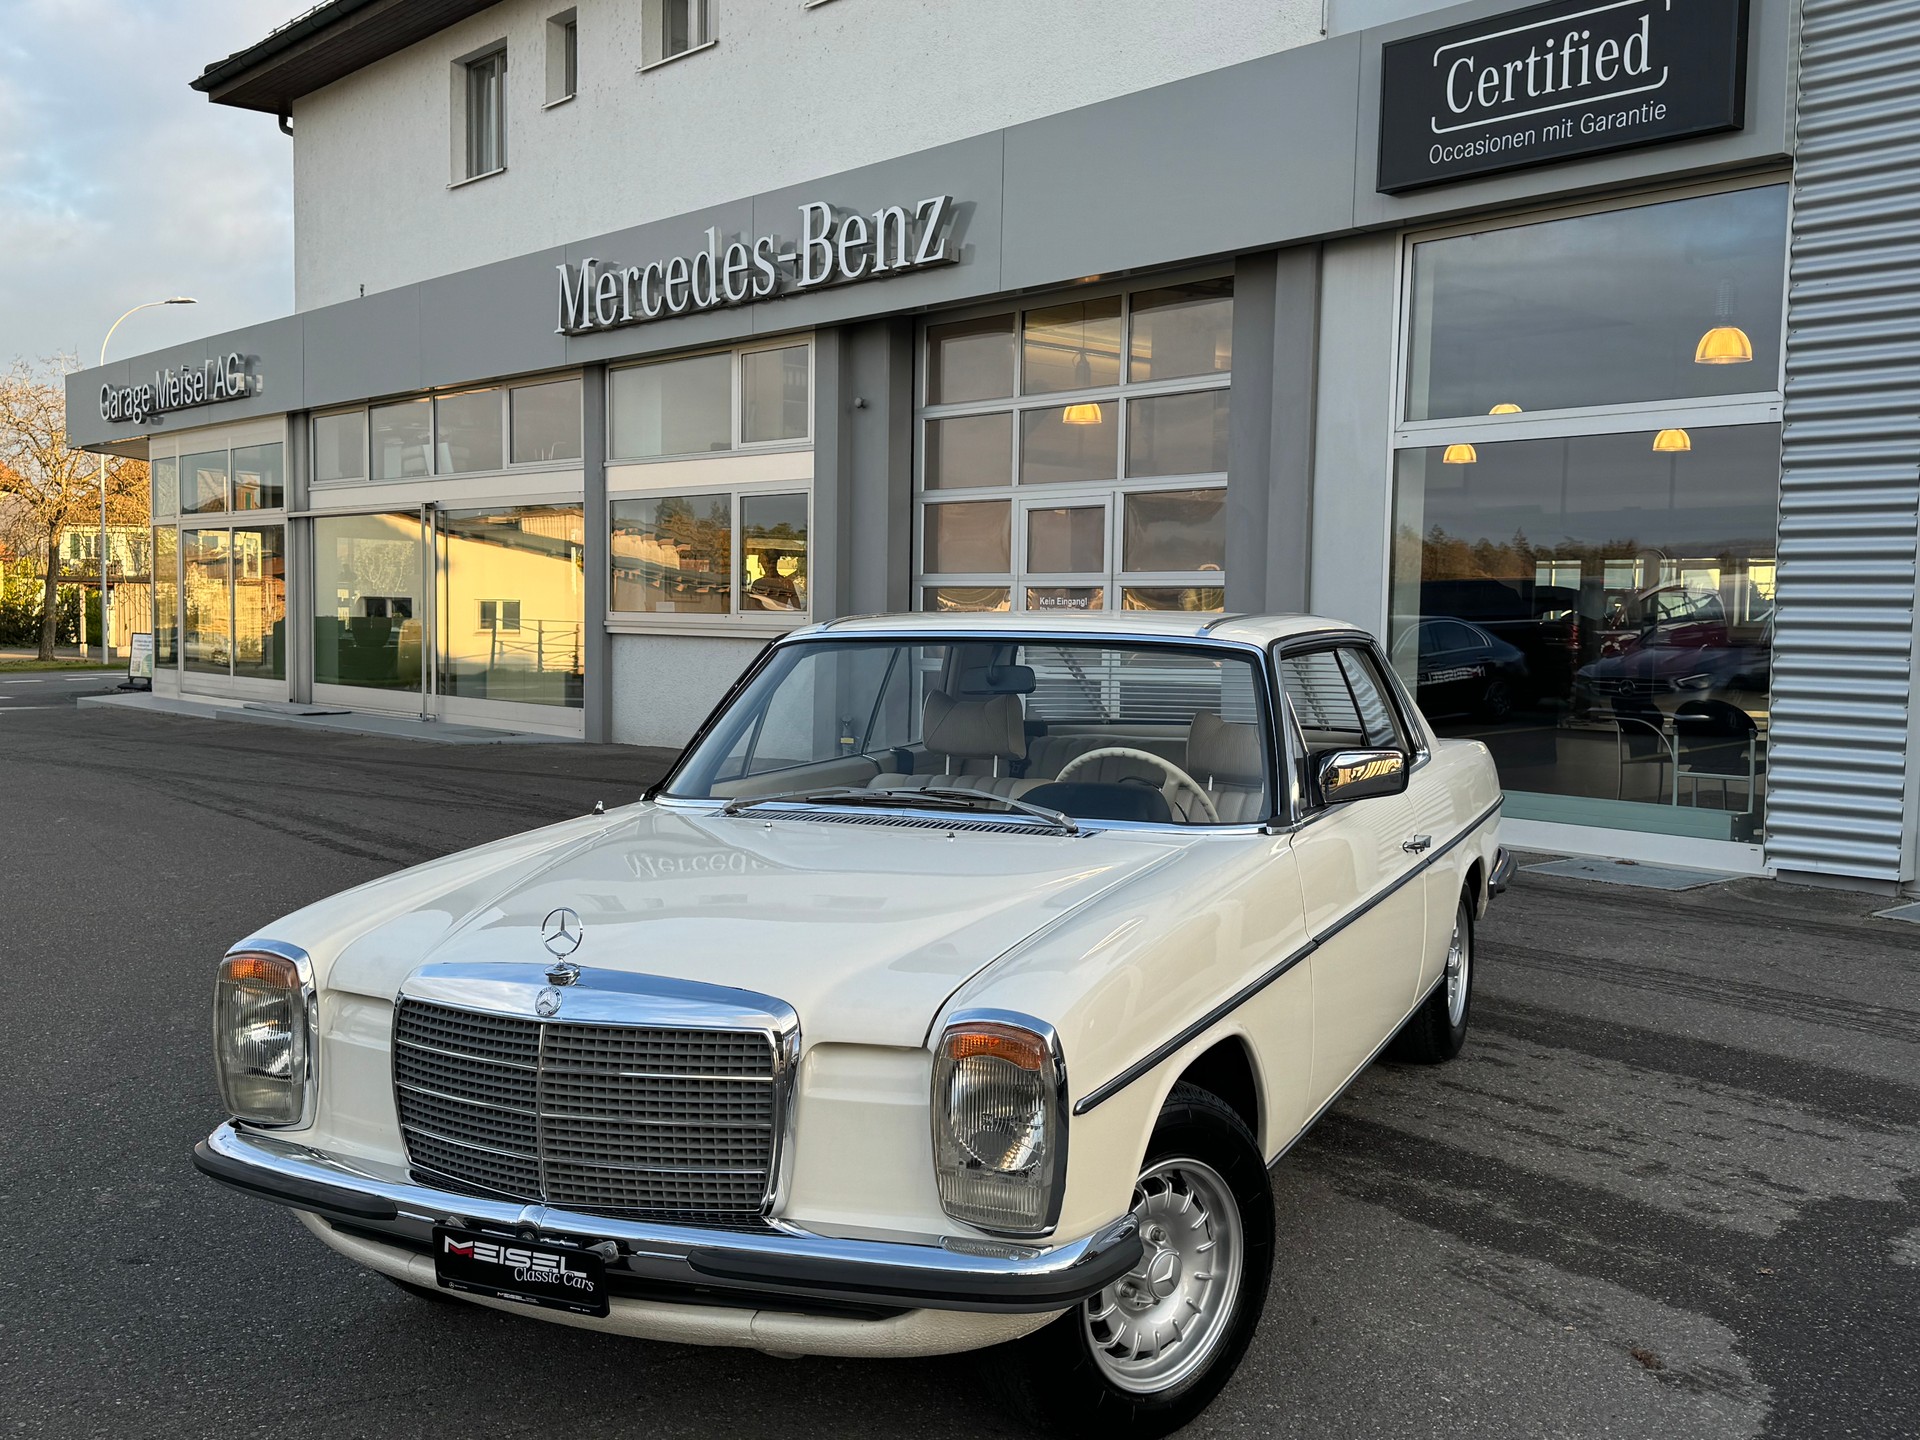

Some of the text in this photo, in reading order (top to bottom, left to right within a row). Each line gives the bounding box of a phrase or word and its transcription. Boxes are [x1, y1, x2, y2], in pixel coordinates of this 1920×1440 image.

[1446, 14, 1652, 114] Certified
[1429, 100, 1667, 165] Occasionen mit Garantie
[554, 195, 953, 334] Mercedes-Benz
[100, 352, 242, 424] Garage Meisel AG
[1040, 597, 1055, 605] Kein
[444, 1235, 587, 1278] MEISEL
[514, 1266, 594, 1292] Classic Cars
